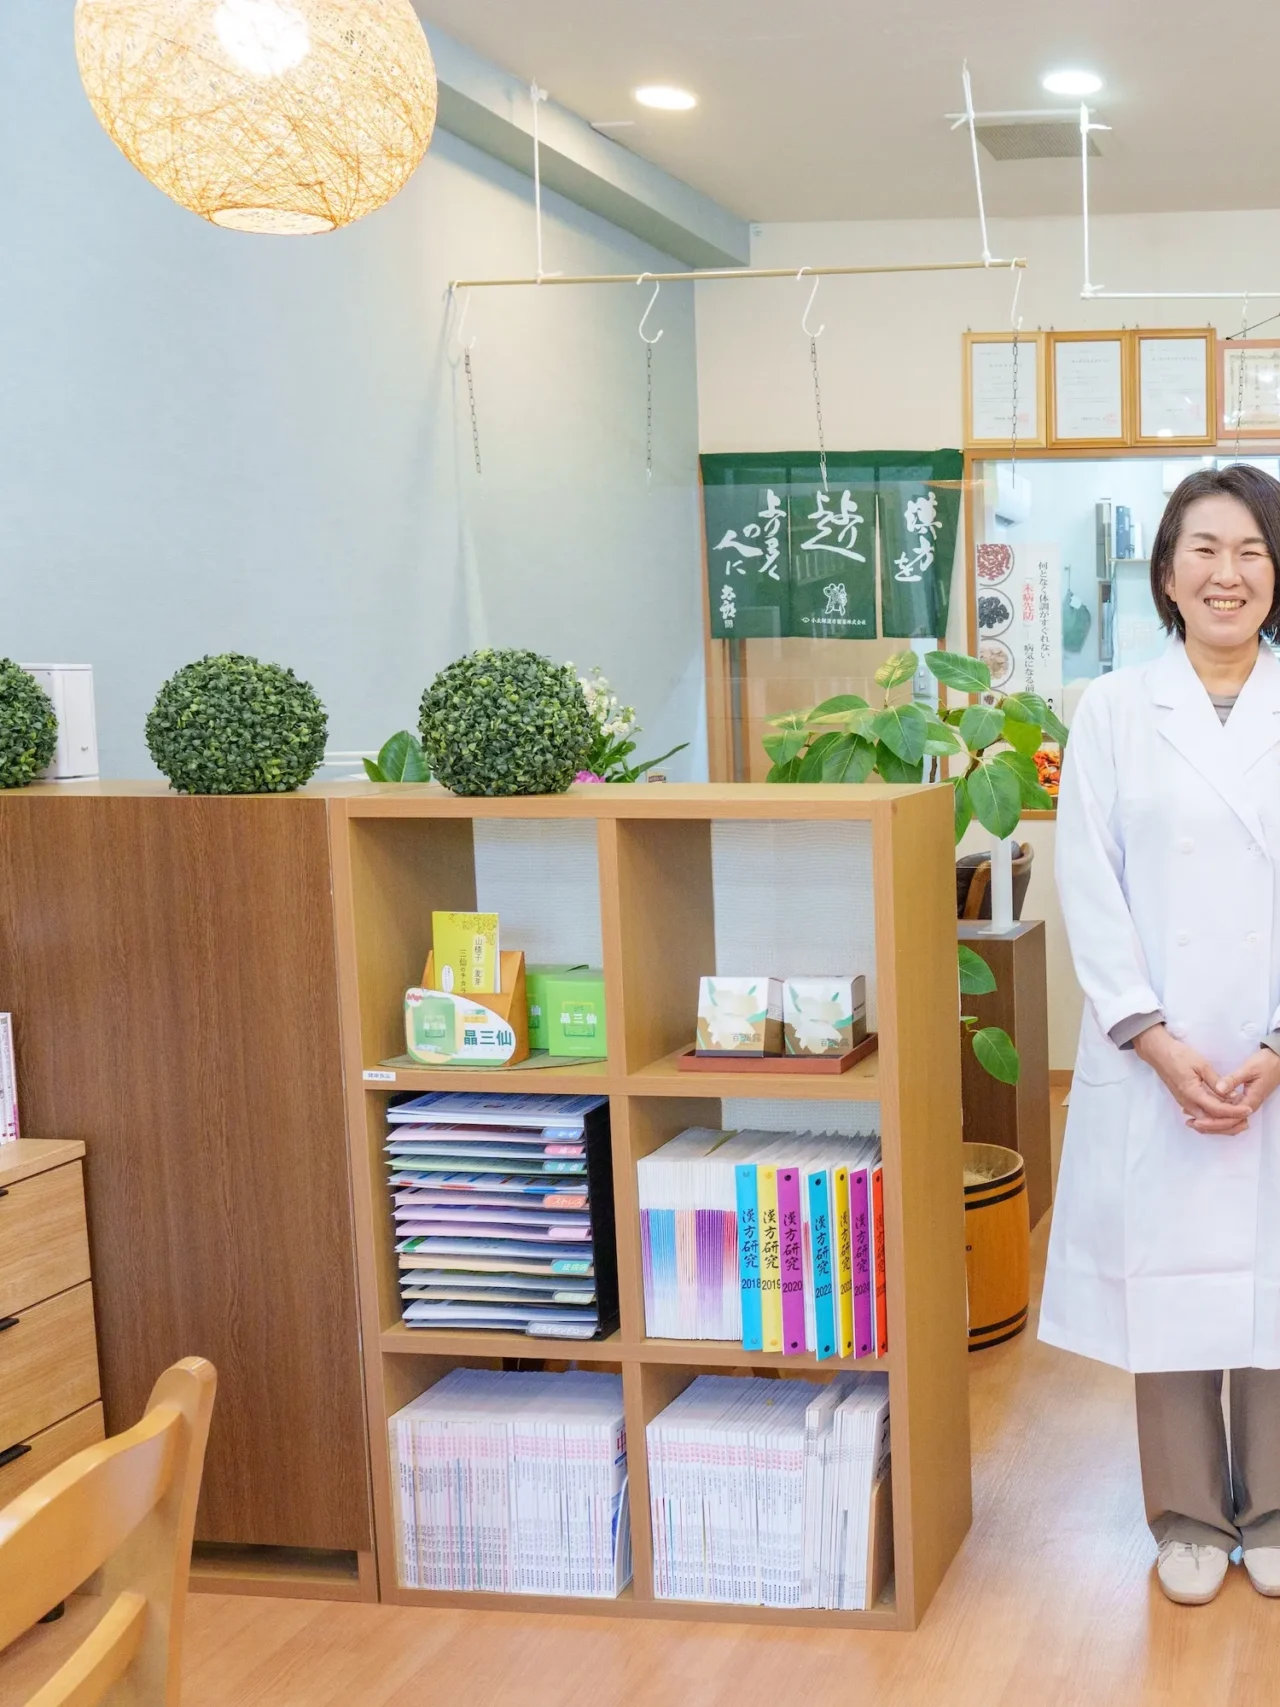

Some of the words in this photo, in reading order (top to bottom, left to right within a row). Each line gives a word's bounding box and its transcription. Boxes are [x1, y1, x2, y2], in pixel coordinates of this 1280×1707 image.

[464, 1029, 512, 1046] 晶三仙
[742, 1208, 759, 1269] 漢方研究
[762, 1208, 780, 1270] 漢方研究
[782, 1211, 801, 1272] 漢方研究
[815, 1214, 829, 1276] 漢方研究
[855, 1212, 868, 1274] 漢方研究
[741, 1278, 761, 1290] 2018
[782, 1281, 803, 1293] 2020
